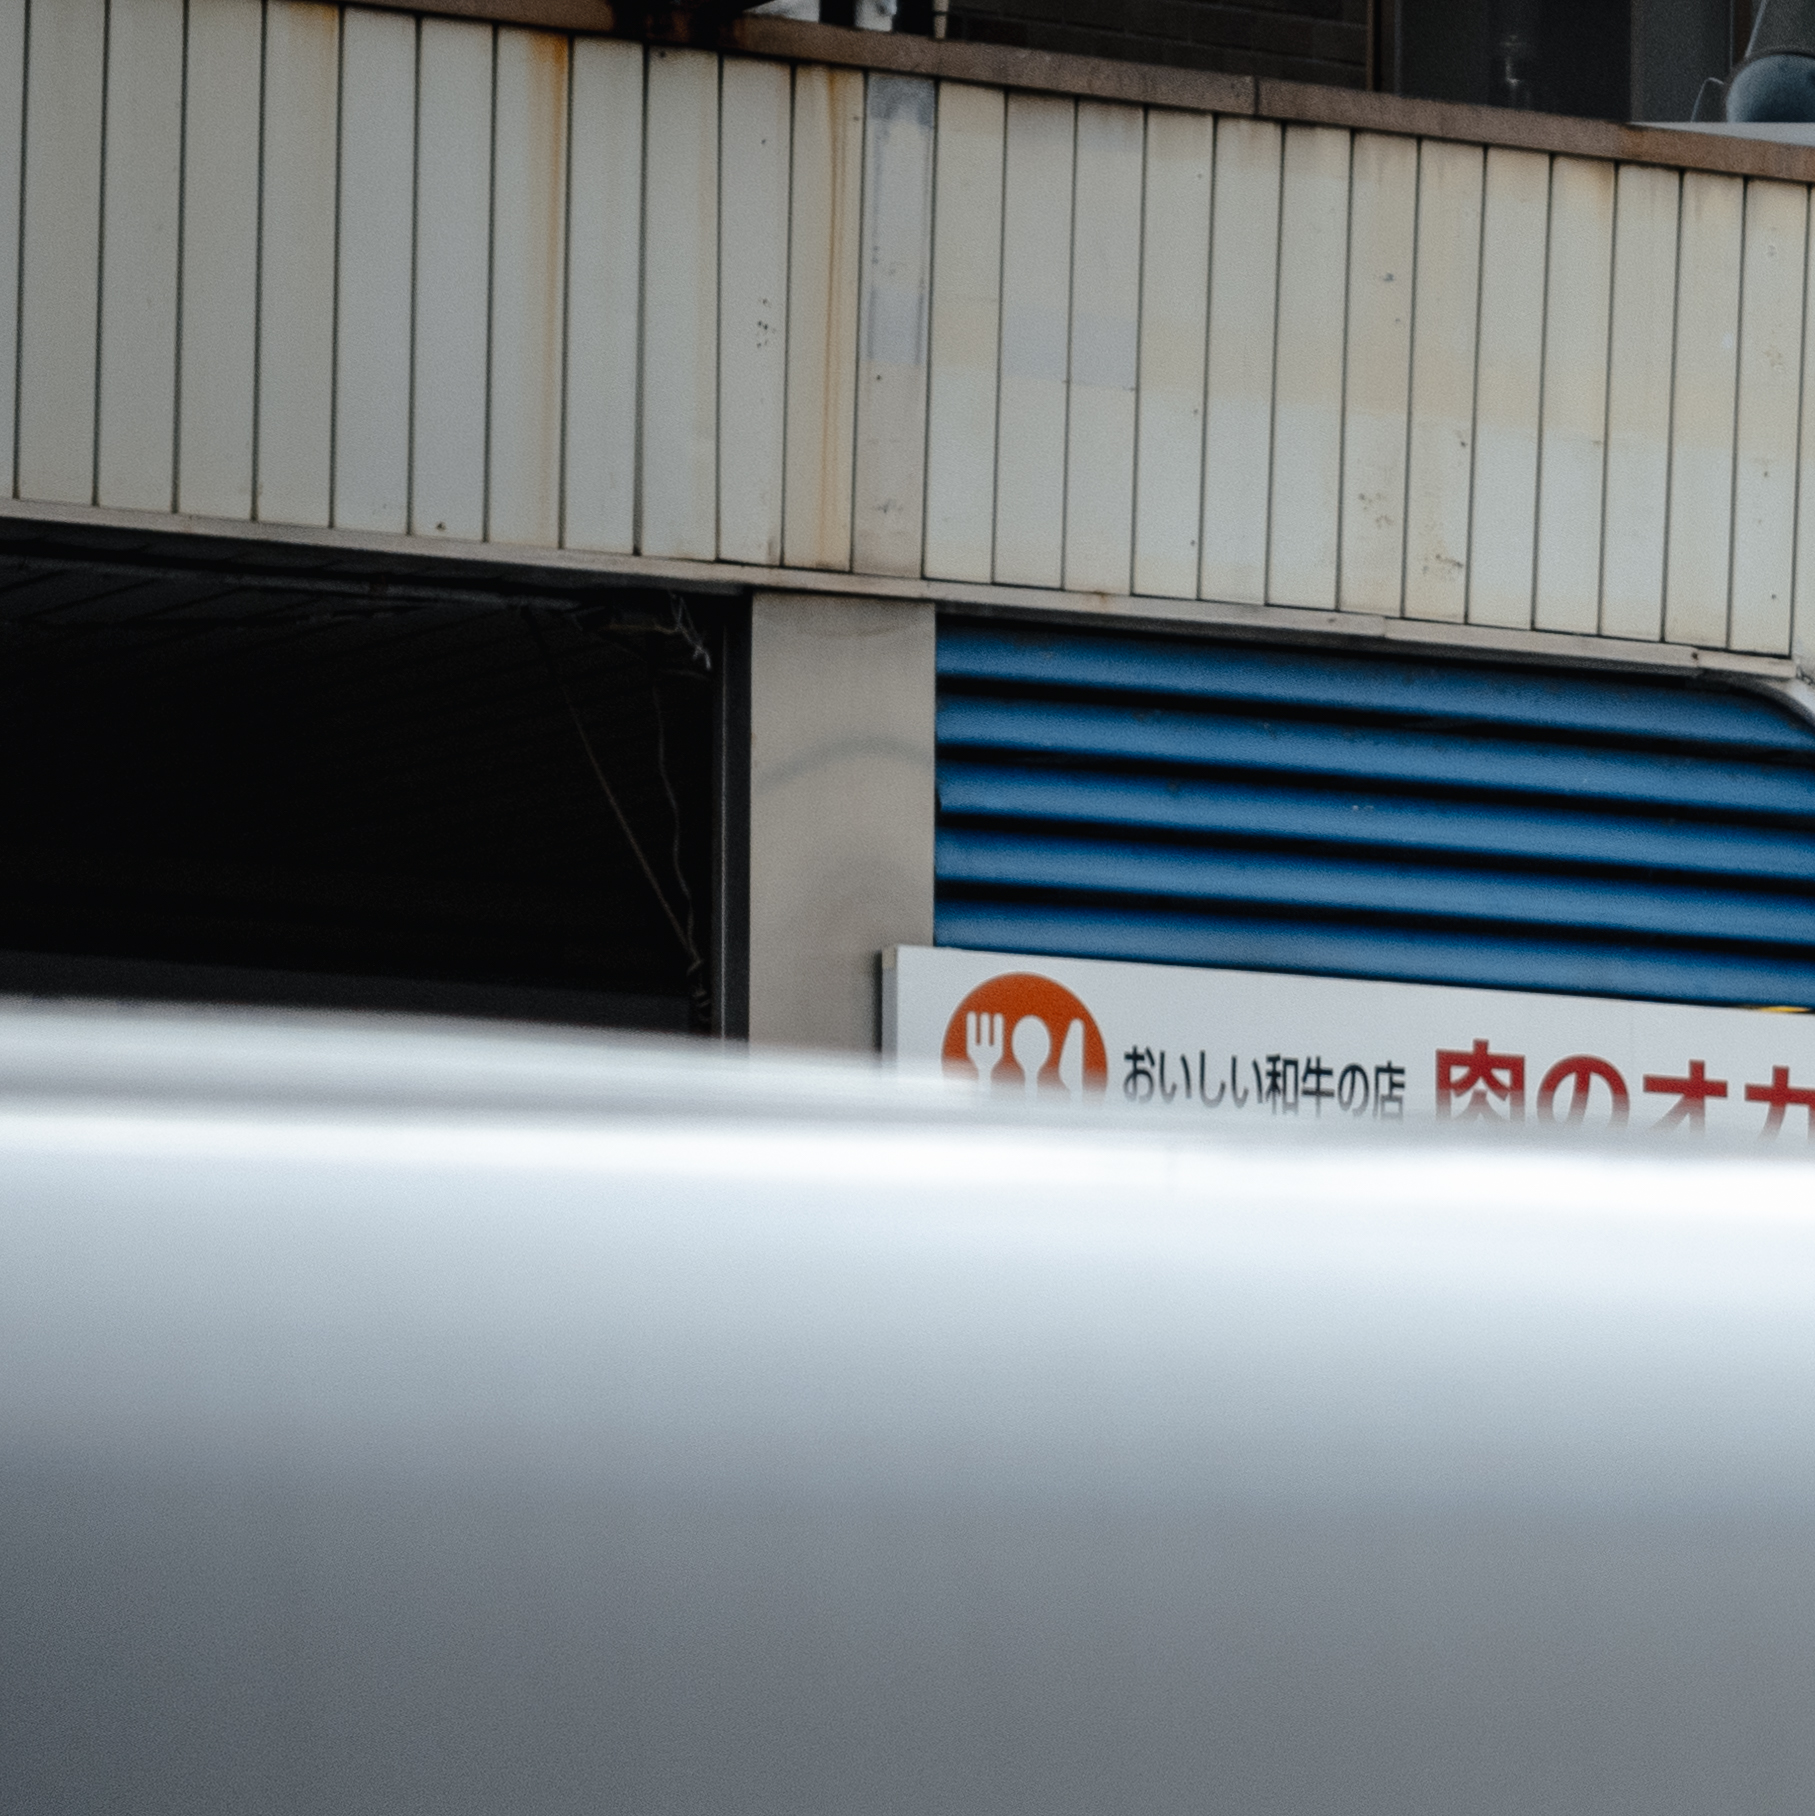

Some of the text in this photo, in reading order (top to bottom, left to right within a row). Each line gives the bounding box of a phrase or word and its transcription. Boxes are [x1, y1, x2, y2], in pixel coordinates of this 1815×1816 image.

[1122, 1044, 1406, 1122] おいしい和牛の店
